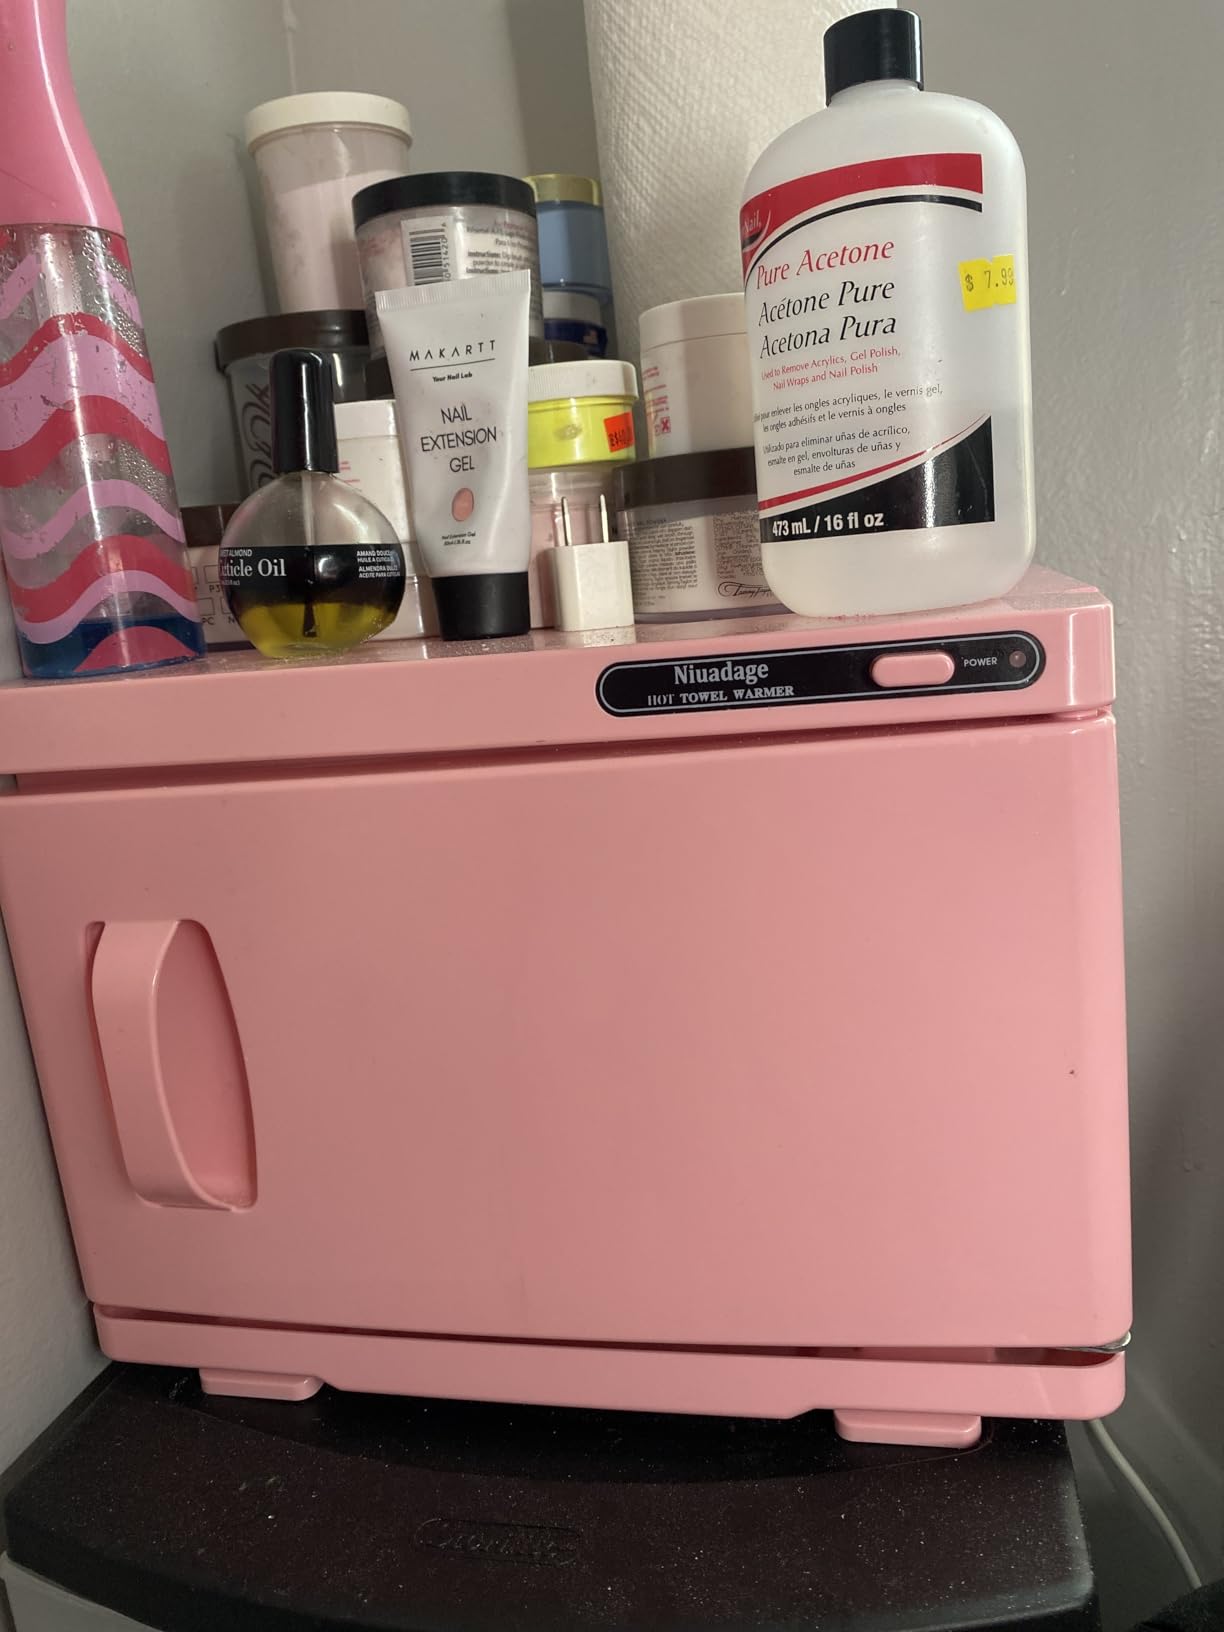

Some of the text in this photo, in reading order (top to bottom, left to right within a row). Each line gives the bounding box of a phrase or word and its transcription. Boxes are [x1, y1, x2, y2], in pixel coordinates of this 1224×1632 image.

[757, 241, 894, 290] Pure Acetone
[964, 267, 1014, 293] $ 7.99
[758, 280, 895, 327] Acétone Pure
[760, 315, 897, 359] Acetona Pura
[409, 339, 496, 362] MAKARTT
[774, 369, 781, 377] to
[781, 362, 810, 375] Remove
[811, 353, 847, 369] Acrylics,
[850, 349, 867, 361] Gel
[869, 345, 901, 359] Polish,
[447, 372, 460, 381] Nail
[461, 371, 473, 379] Lab
[773, 362, 878, 391] Nail Wraps and Nail Polish
[793, 403, 803, 413] les
[804, 398, 830, 412] ongles
[832, 393, 881, 406] acryliques,
[884, 388, 893, 399] le
[895, 386, 923, 398] vernis
[926, 383, 944, 398] gel,
[440, 403, 473, 425] NAIL
[788, 413, 817, 427] adhésifs
[818, 413, 826, 422] et
[828, 410, 836, 420] le
[838, 407, 865, 419] vernis
[867, 405, 873, 415] à
[875, 402, 907, 416] ongles
[420, 426, 497, 452] EXTENSION
[785, 441, 800, 452] para
[801, 435, 833, 448] eliminar
[835, 431, 857, 442] uñas
[858, 428, 871, 439] de
[872, 425, 911, 438] acrílico,
[449, 455, 476, 474] GEL
[787, 455, 796, 464] en
[797, 450, 810, 465] gel,
[811, 446, 855, 460] envolturas
[856, 443, 869, 454] de
[871, 441, 894, 452] uñas
[895, 441, 902, 452] y
[793, 459, 857, 476] esmalte de uñas
[772, 511, 885, 537] 473 mL / 16 fl oz
[257, 558, 288, 578] Oil
[358, 565, 387, 573] ALMENDRA
[673, 660, 770, 686] Niuadage
[963, 656, 998, 668] POWER
[680, 690, 728, 704] TOWEL
[732, 685, 795, 700] WARMER
